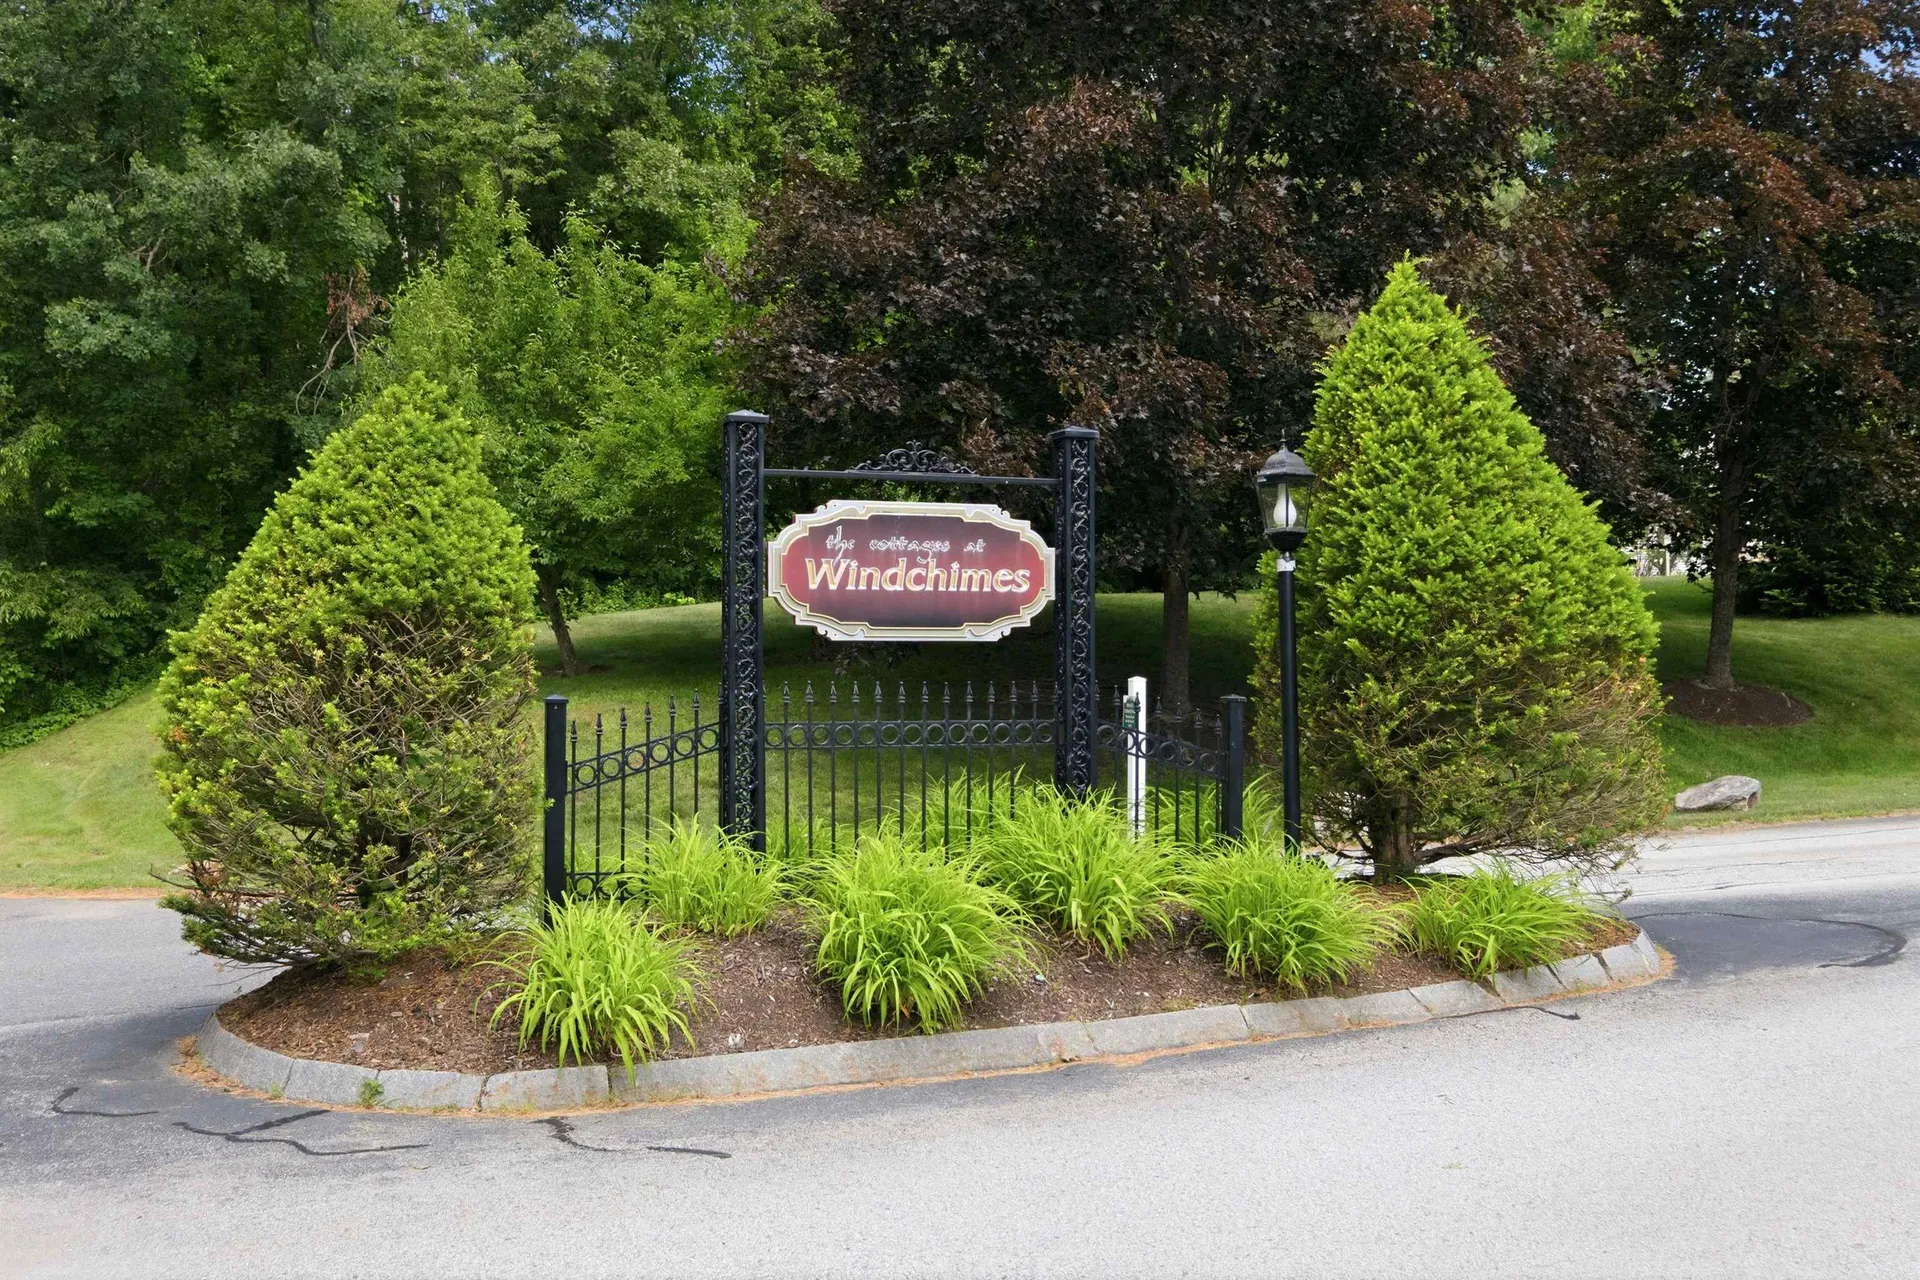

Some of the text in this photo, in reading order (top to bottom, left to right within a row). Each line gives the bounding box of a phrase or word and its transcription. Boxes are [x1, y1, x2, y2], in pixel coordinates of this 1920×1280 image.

[825, 525, 986, 564] the cottages at
[805, 557, 1031, 593] Windchimes
